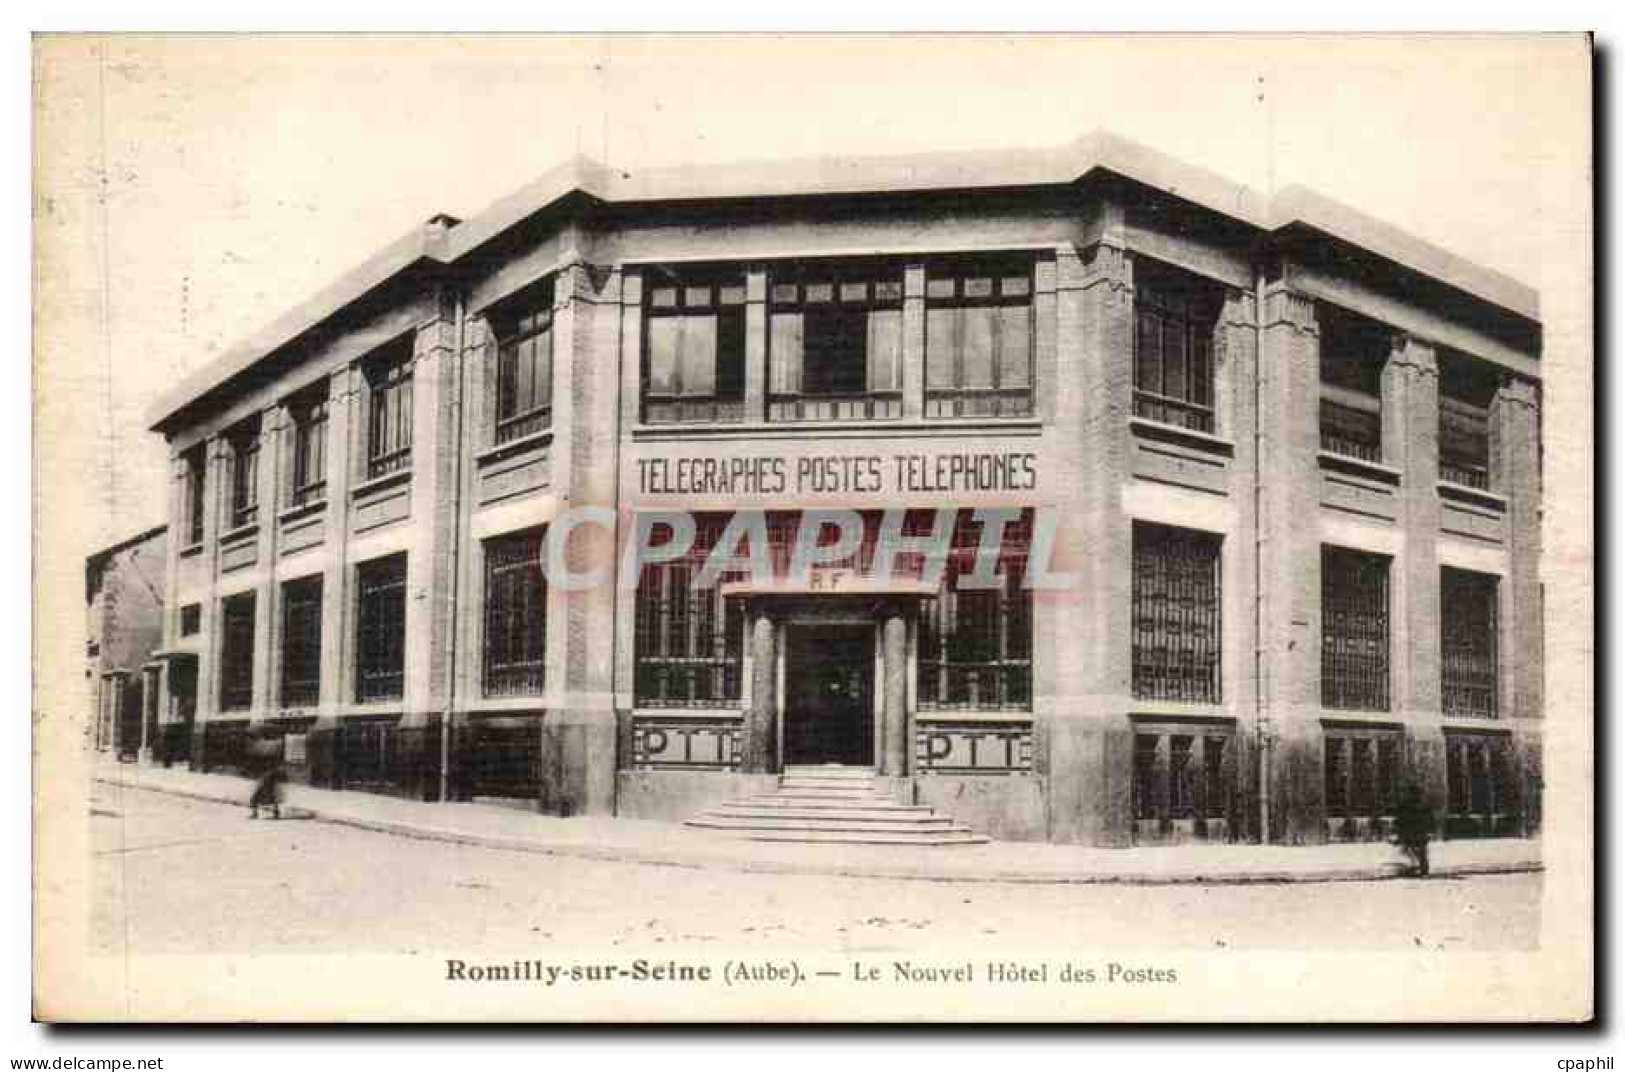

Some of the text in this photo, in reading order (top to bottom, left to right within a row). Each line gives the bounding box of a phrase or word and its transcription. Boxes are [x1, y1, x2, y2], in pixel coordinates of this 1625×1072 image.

[637, 453, 1037, 495] TELEGRAPHES POSTES TELEPHONES
[640, 728, 732, 762] PTT
[924, 732, 1026, 767] PTT
